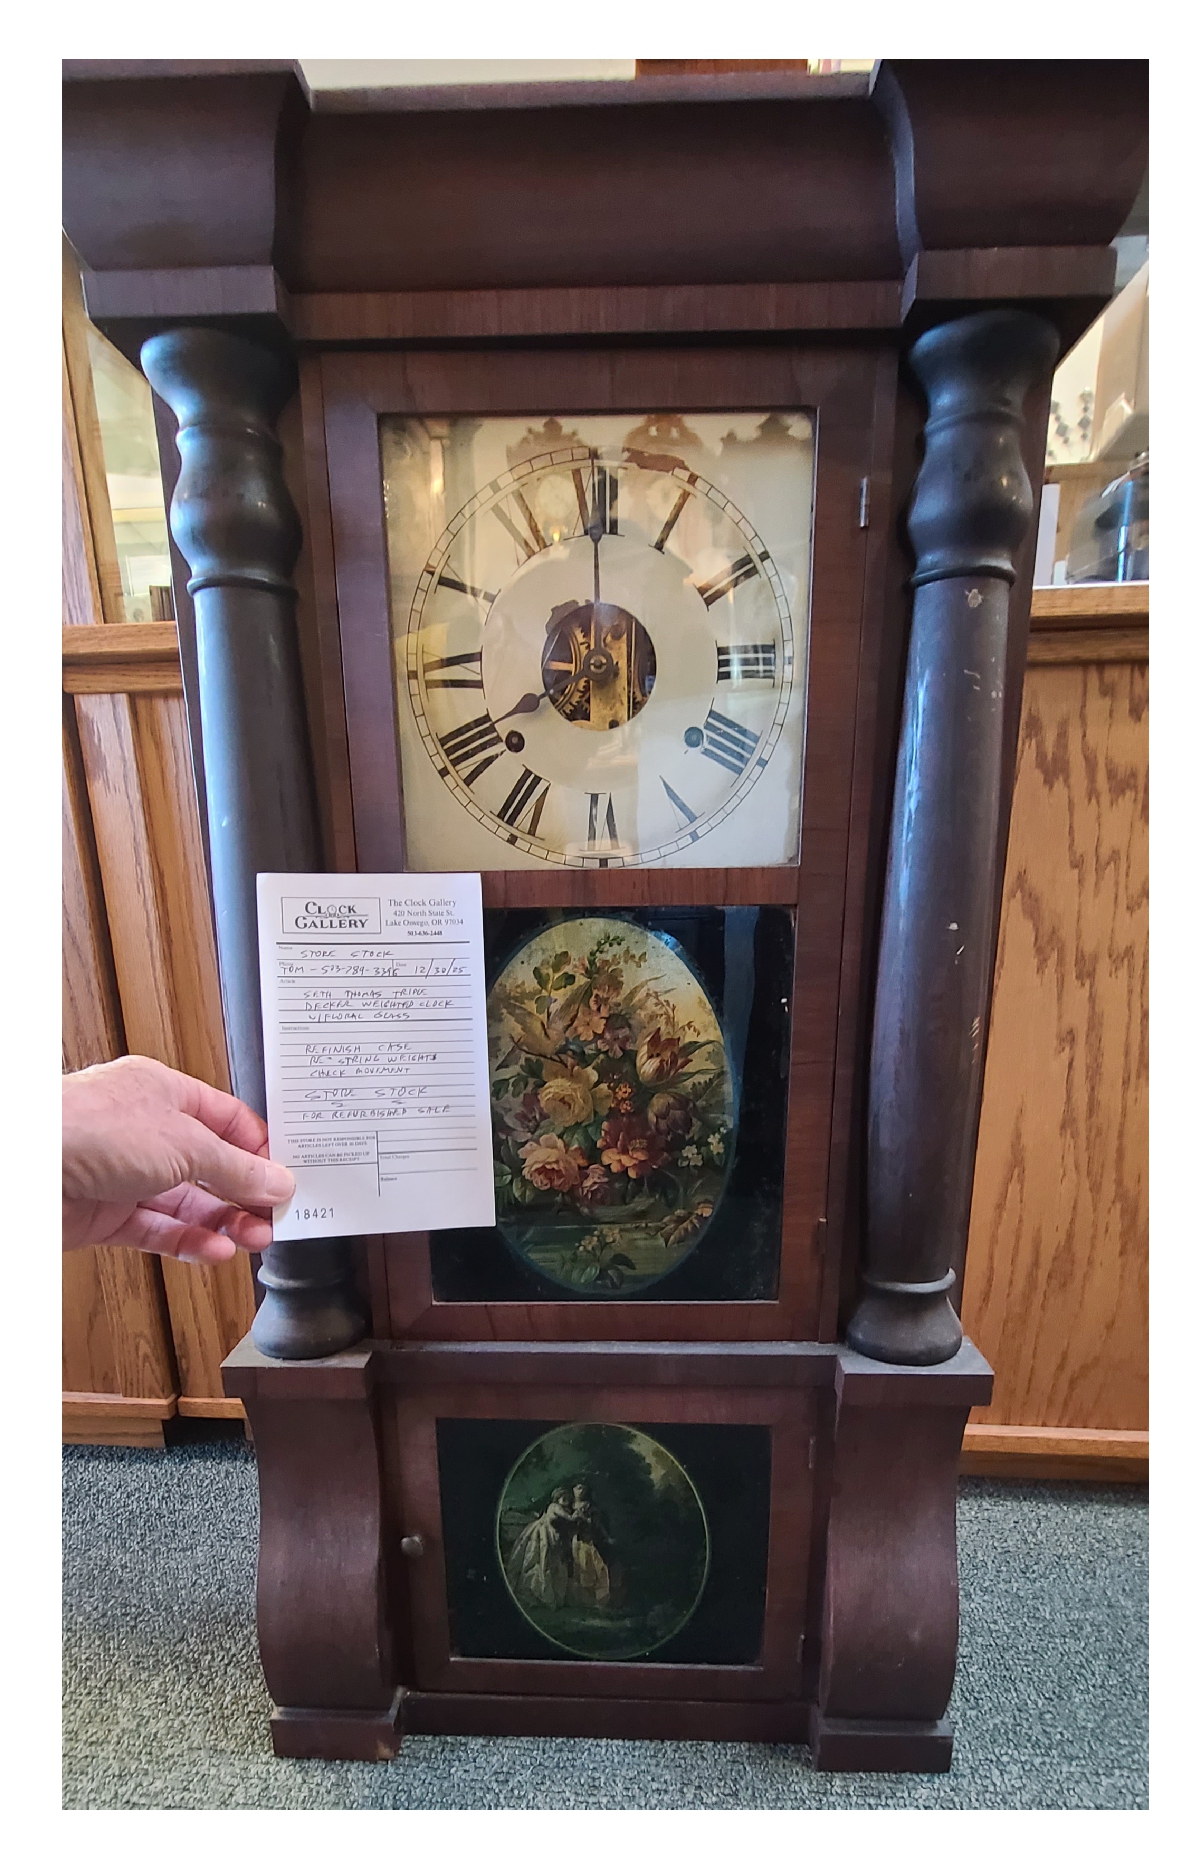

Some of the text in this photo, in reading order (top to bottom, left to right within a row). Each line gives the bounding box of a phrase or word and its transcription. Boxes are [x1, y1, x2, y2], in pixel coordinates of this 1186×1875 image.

[563, 466, 625, 539] XII
[649, 470, 700, 554] I
[486, 479, 554, 575] XI
[694, 547, 771, 612] II
[426, 554, 501, 626] X
[716, 639, 777, 687] III
[422, 645, 484, 701] IX
[436, 708, 506, 794] VIII
[489, 764, 551, 840] VII
[659, 776, 704, 832] V
[580, 792, 626, 852] VI
[388, 898, 457, 908] The Clock Gallery
[428, 909, 444, 917] State
[295, 915, 368, 929] GALLERY
[385, 919, 402, 927] Lake
[403, 919, 430, 927] Oswego,
[445, 918, 464, 926] 97034
[301, 950, 394, 959] STORE STOCK
[280, 965, 304, 975] TOM
[304, 990, 331, 999] SETH
[345, 989, 382, 999] THOMAS
[306, 1000, 455, 1011] DECKER WEIGHTED CLOCK
[378, 1043, 412, 1052] CASE
[310, 1066, 410, 1078] CHECK MOVEMENT
[304, 1086, 428, 1101] STORE STOCK
[302, 1104, 451, 1121] FOR REFURBISHED SALE
[295, 1207, 334, 1220] 18421
